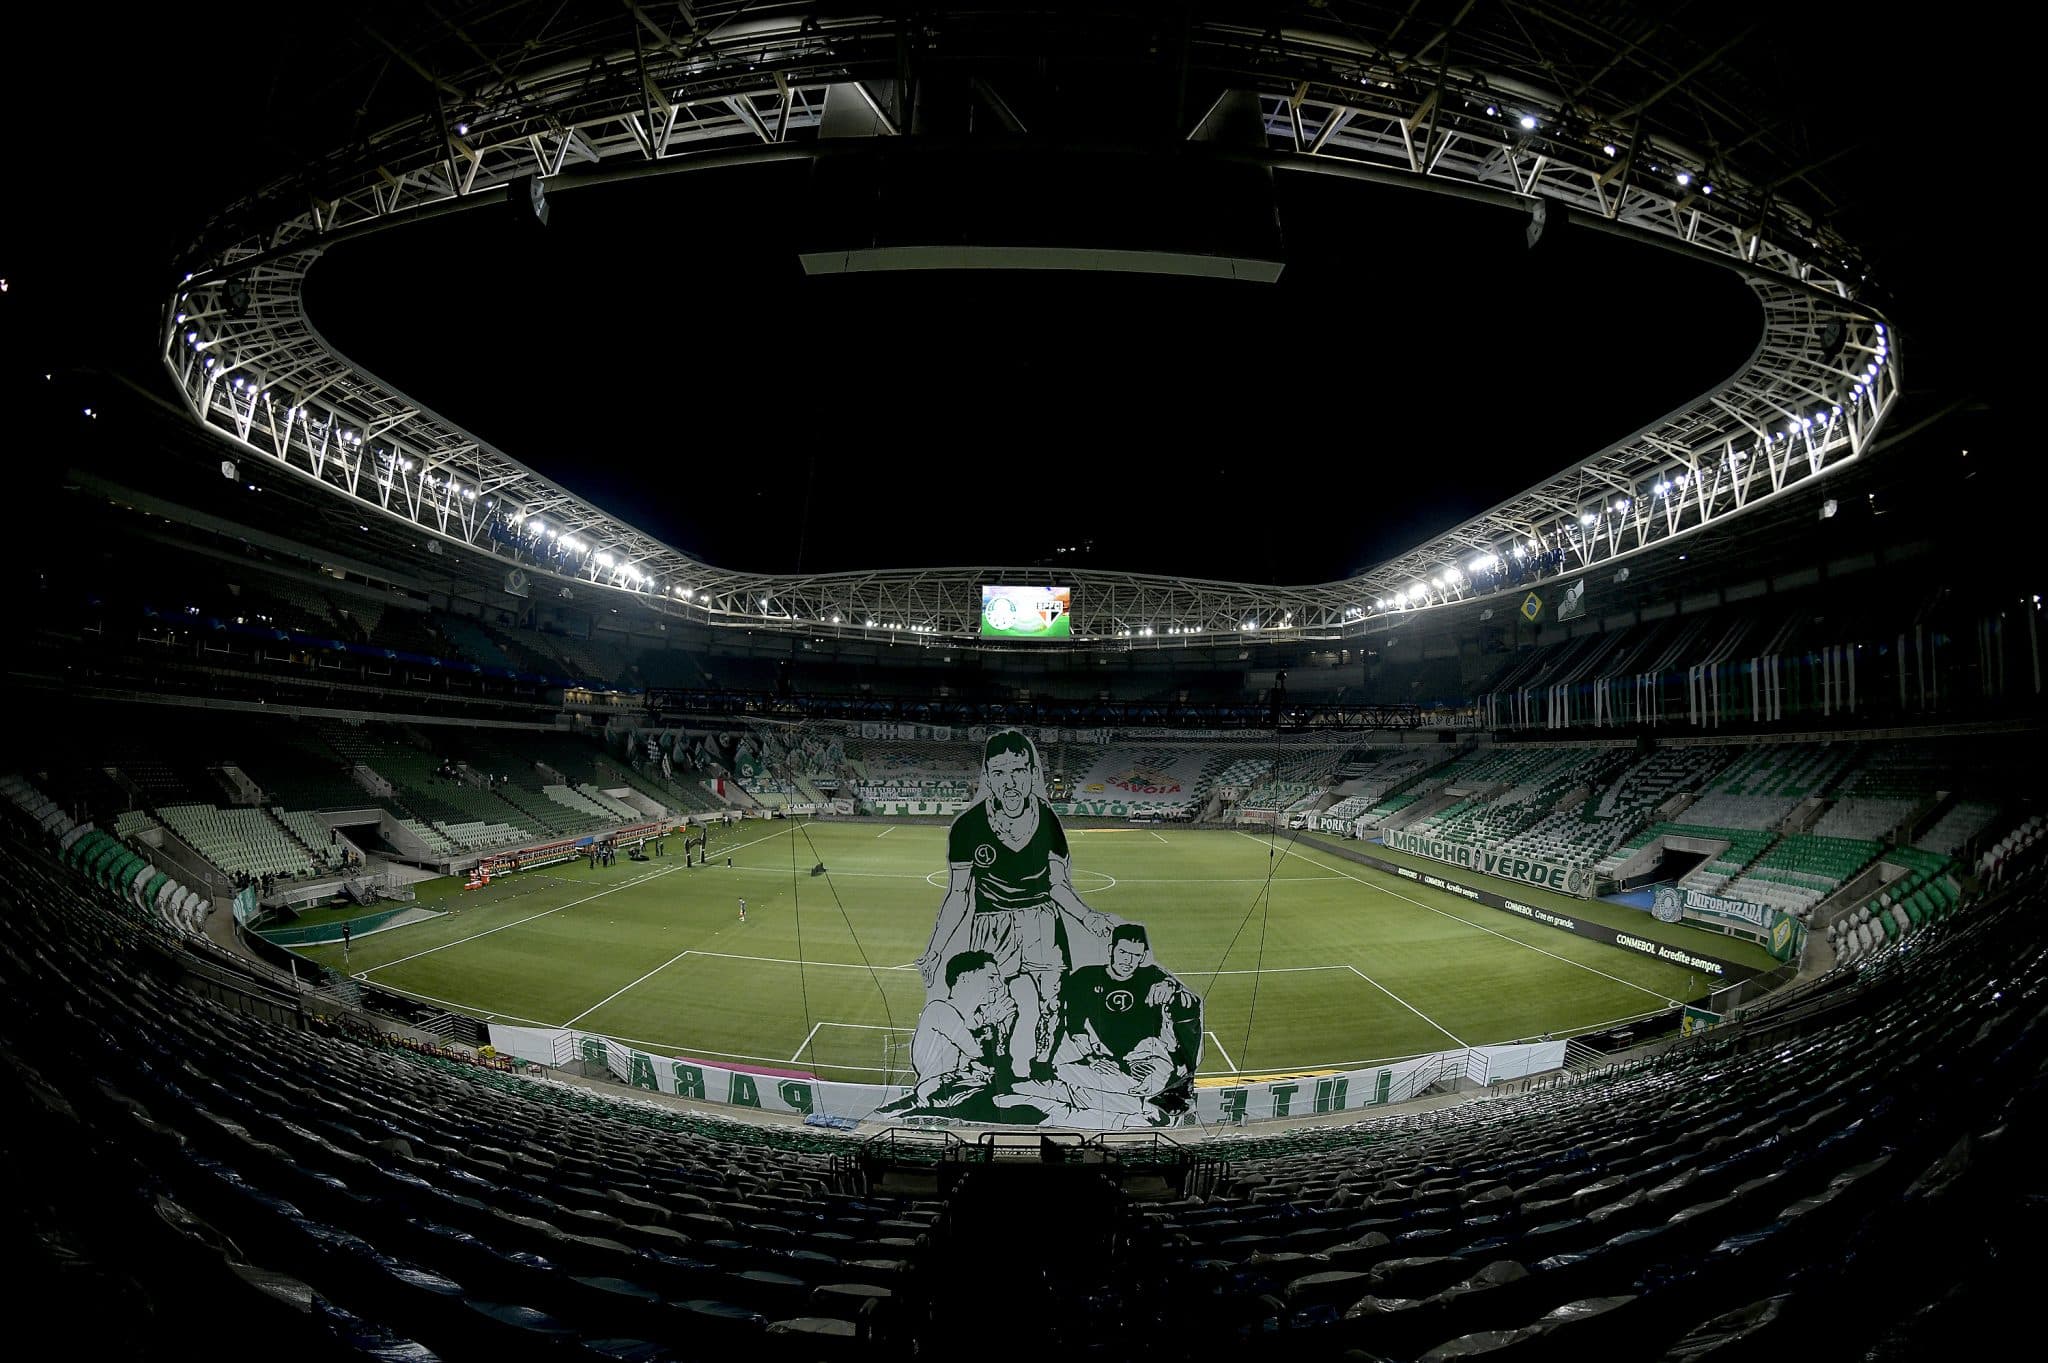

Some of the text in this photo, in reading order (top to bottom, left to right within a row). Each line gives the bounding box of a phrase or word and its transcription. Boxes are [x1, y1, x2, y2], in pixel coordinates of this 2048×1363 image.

[1105, 776, 1182, 795] SAVOIA
[1393, 834, 1566, 889] MANCHA VERDE
[1504, 900, 1534, 917] CONMEBOL
[1534, 909, 1547, 922] Cree
[1546, 914, 1555, 924] en
[1686, 889, 1763, 924] UNIFORMIZADA
[1616, 933, 1656, 955] CONMEBOL
[1658, 946, 1690, 965] Acredite
